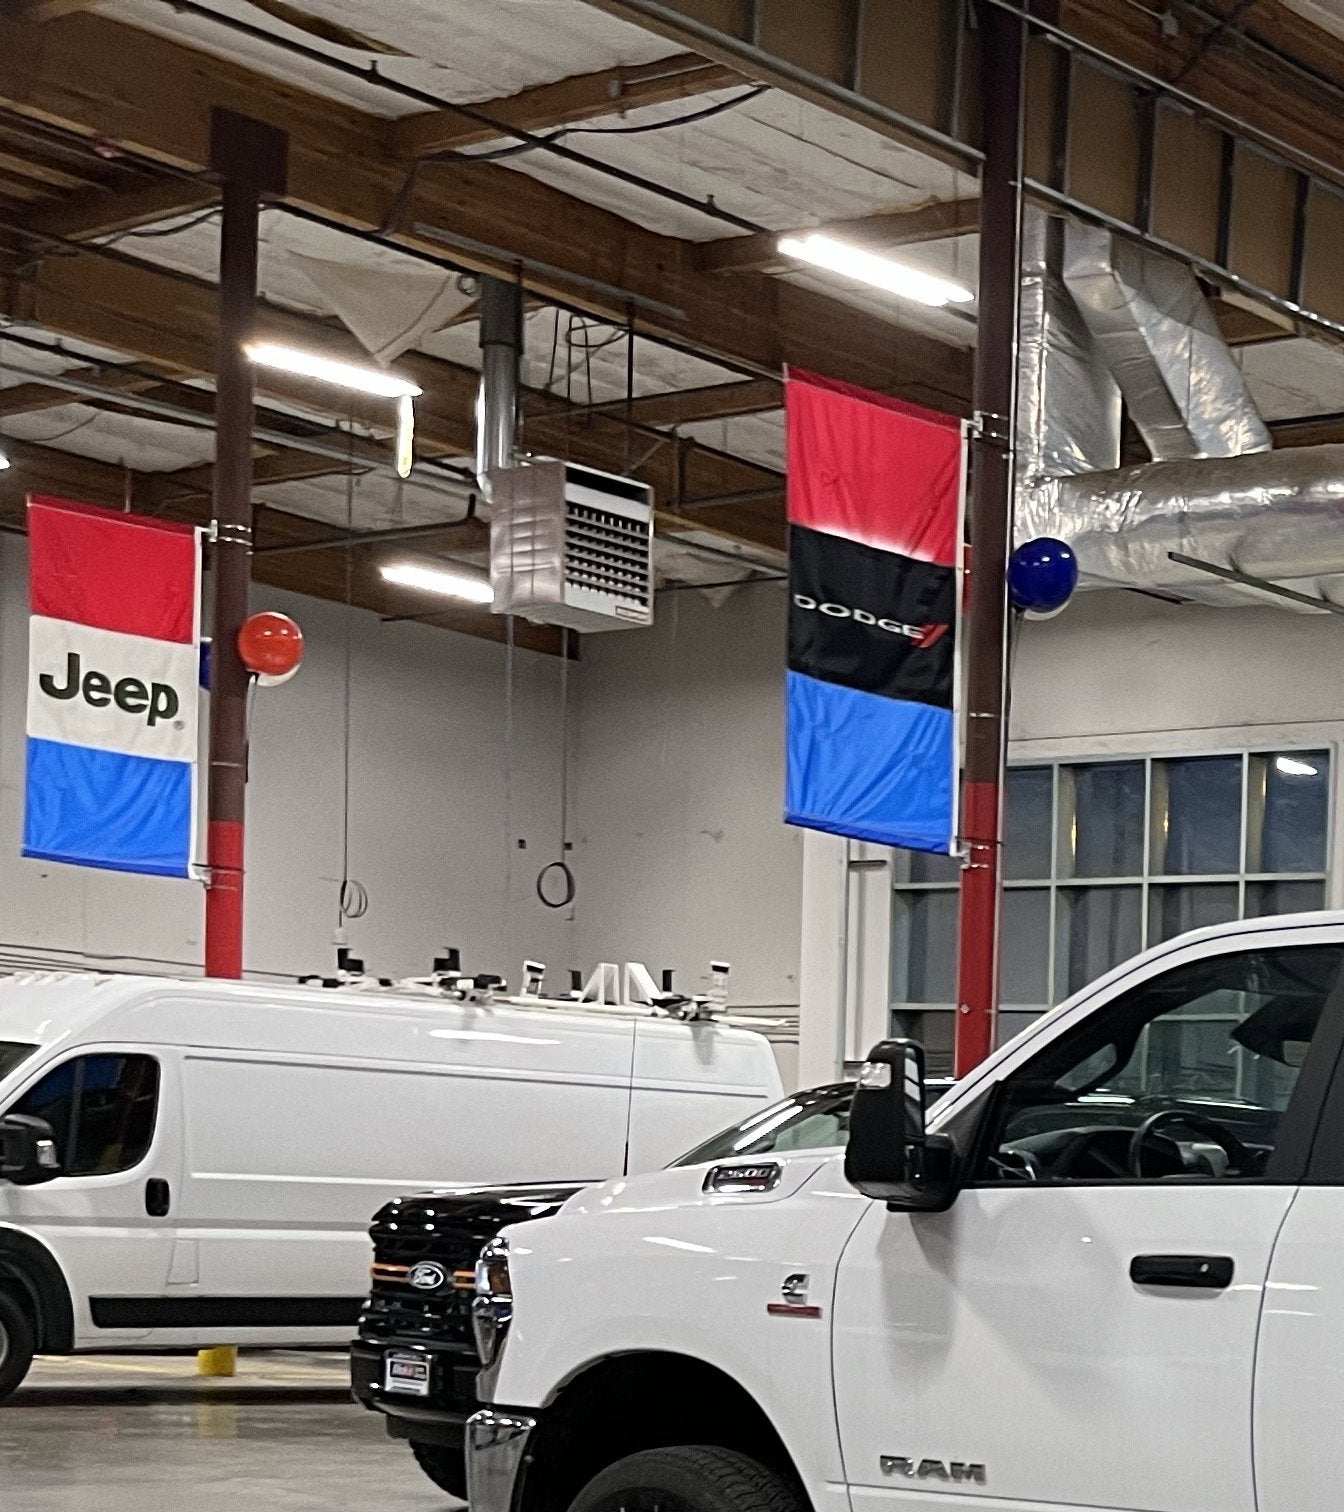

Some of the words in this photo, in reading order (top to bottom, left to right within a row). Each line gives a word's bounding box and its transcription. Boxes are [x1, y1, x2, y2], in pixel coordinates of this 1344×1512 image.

[793, 594, 925, 640] DODGE
[39, 652, 180, 727] Jeep
[880, 1454, 987, 1486] RAM
